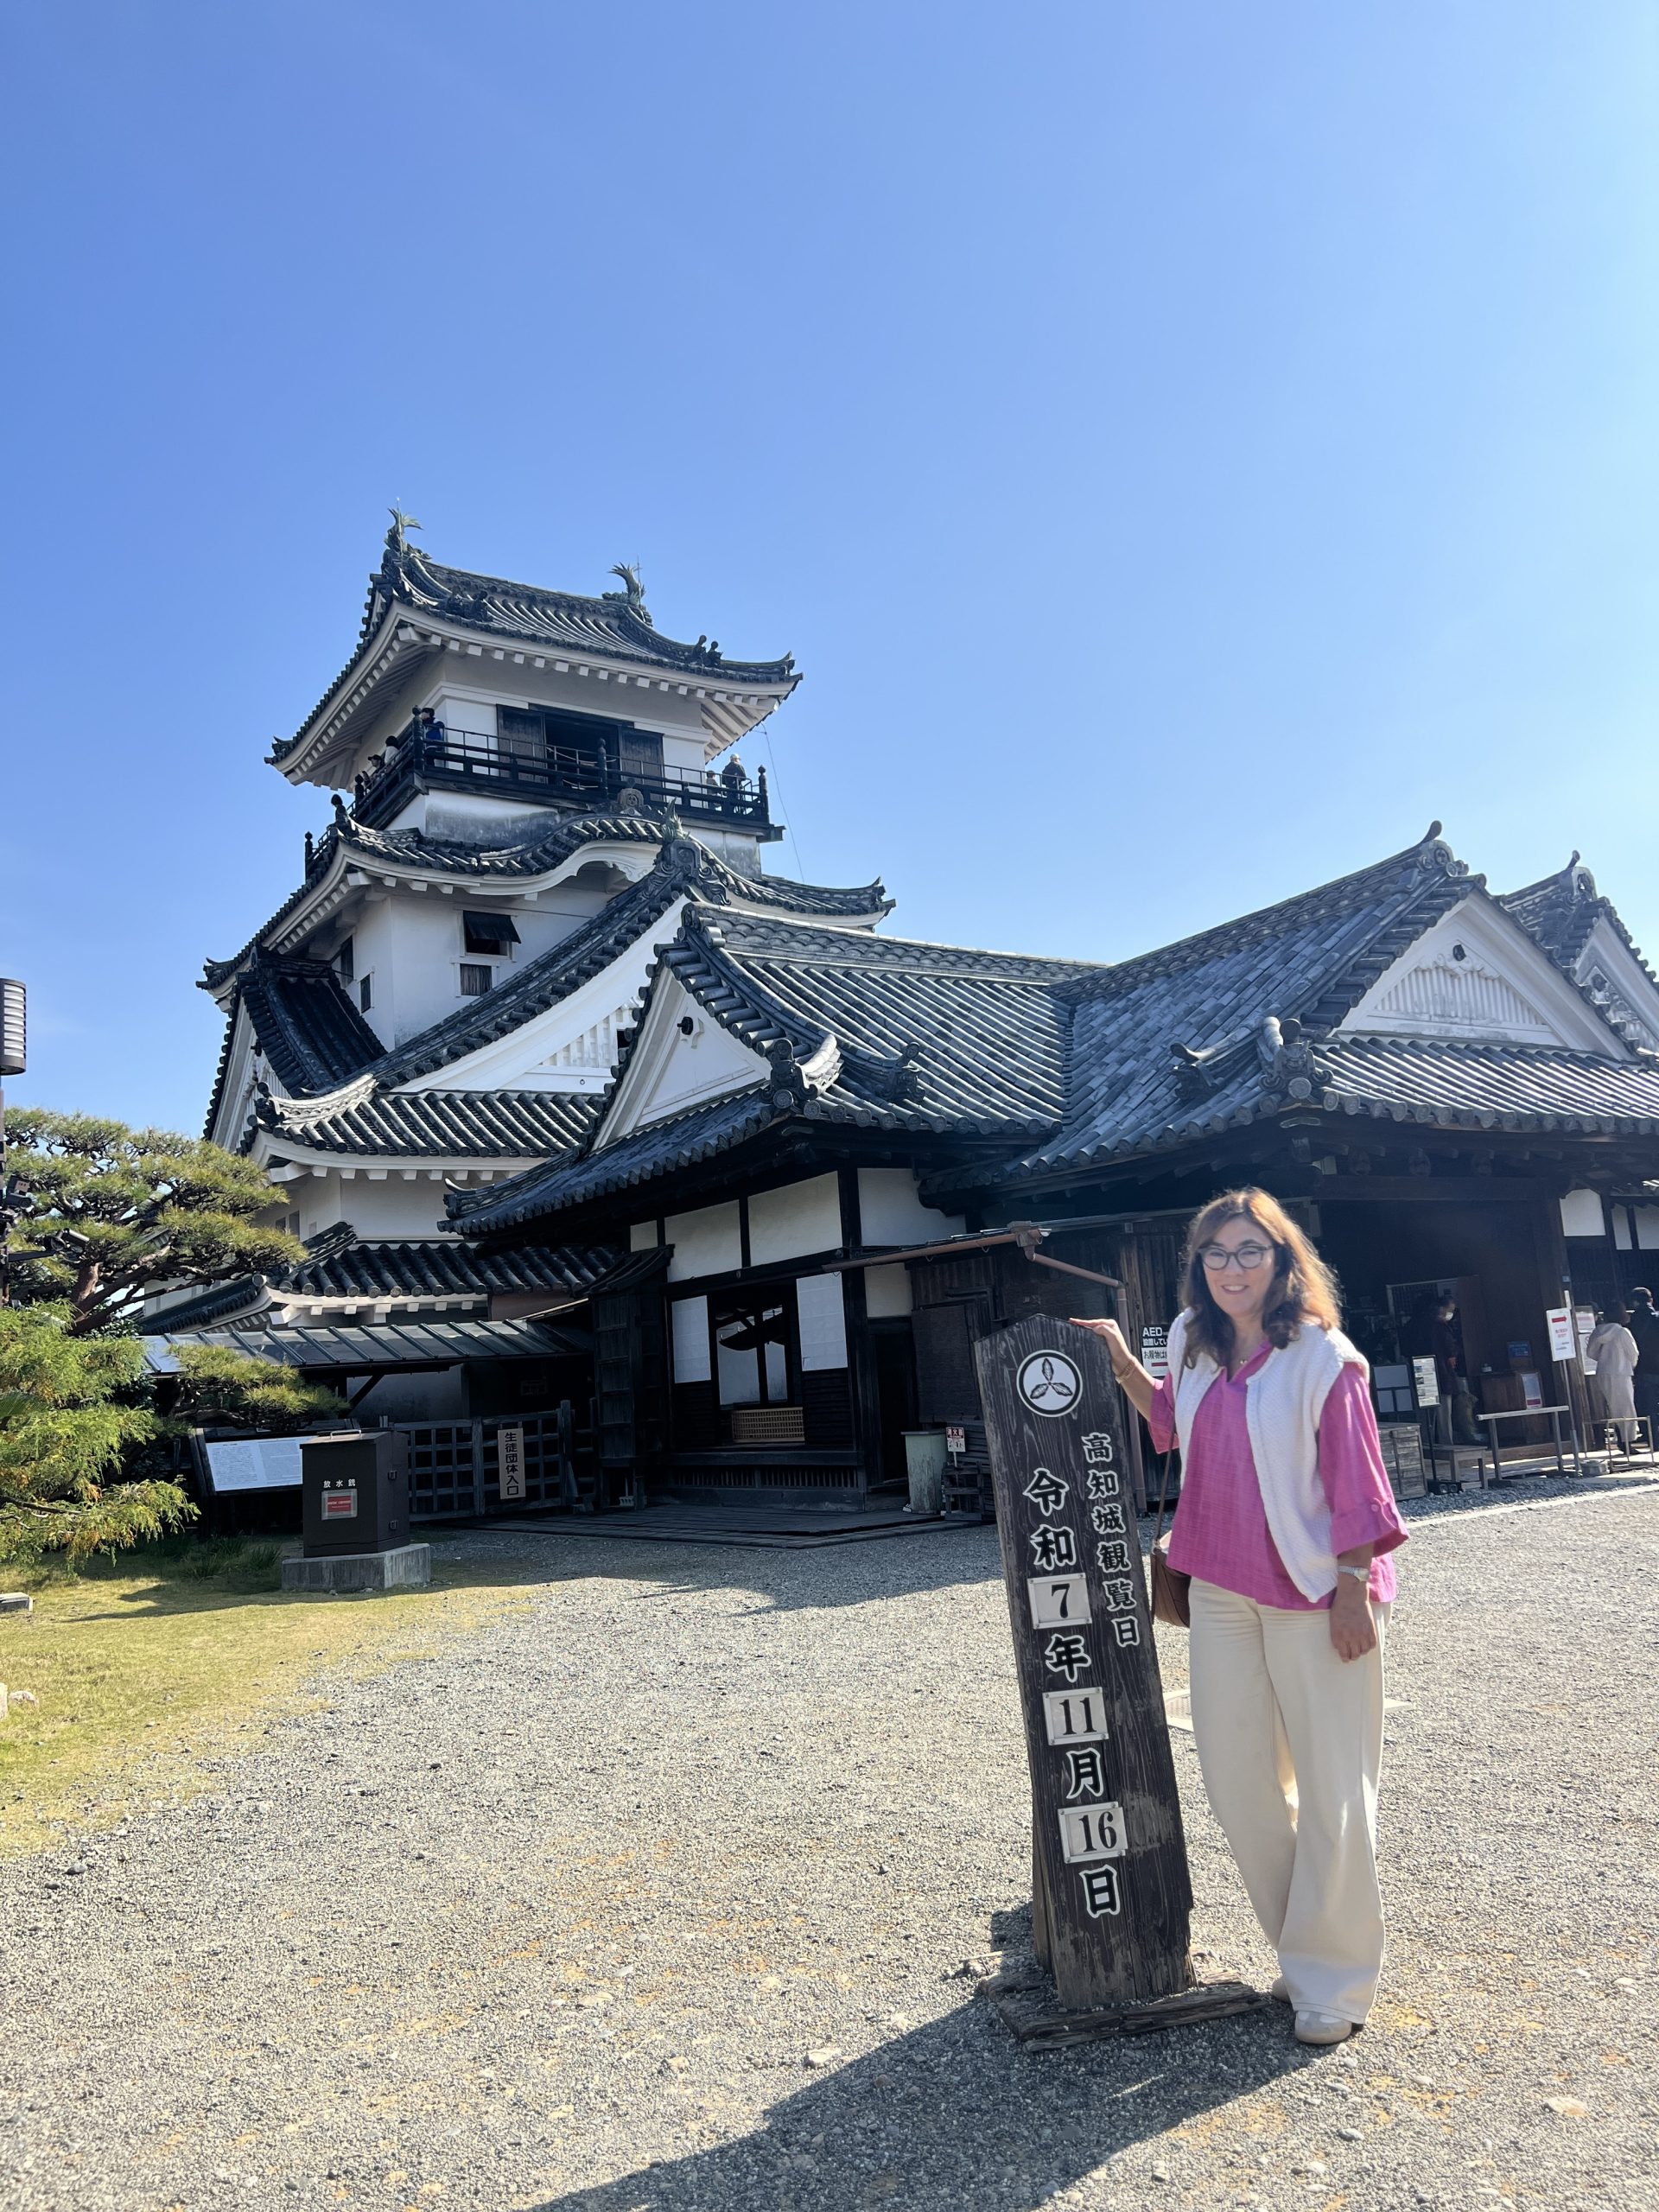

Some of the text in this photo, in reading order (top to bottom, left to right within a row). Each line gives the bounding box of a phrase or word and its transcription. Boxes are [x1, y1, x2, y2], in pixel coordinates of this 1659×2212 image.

[1142, 1327, 1162, 1337] AED
[505, 1432, 518, 1495] 生徒団体入口
[323, 1478, 356, 1488] 放水銃
[1081, 1433, 1140, 1647] 高知城観覧日
